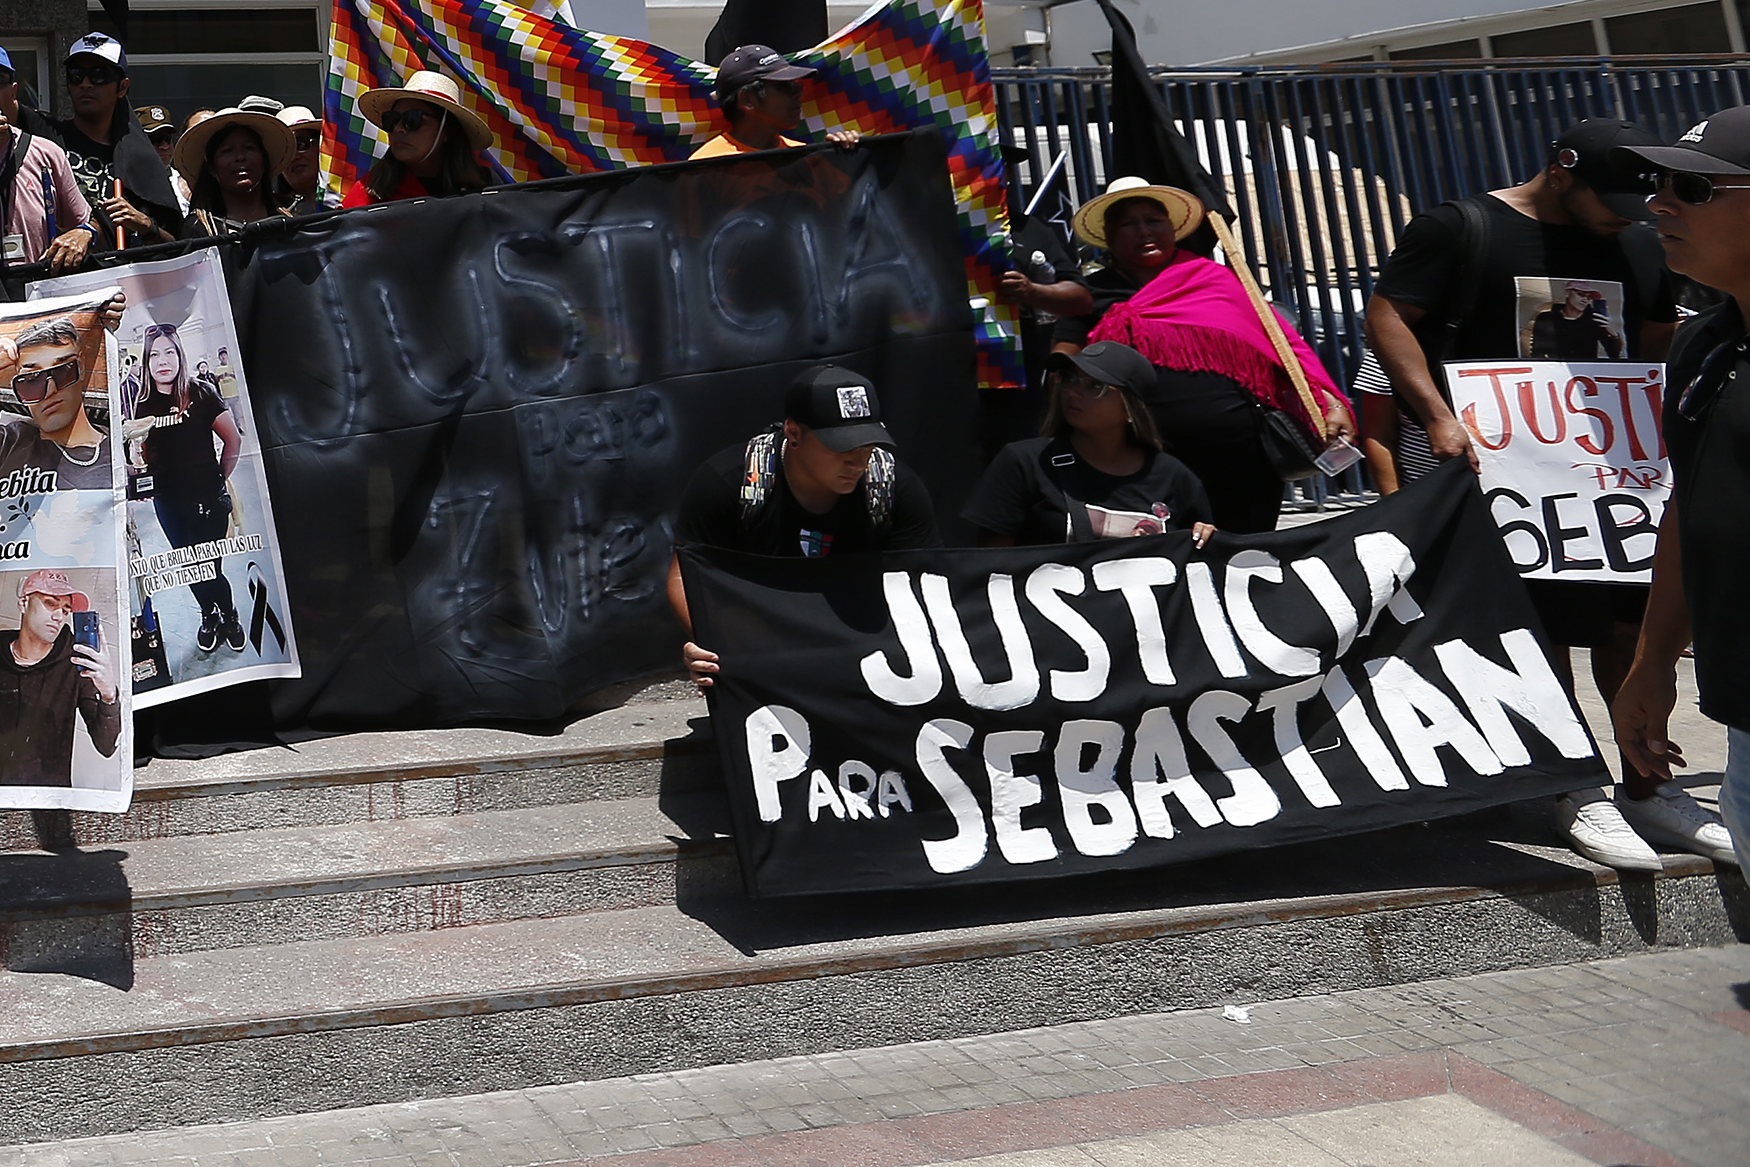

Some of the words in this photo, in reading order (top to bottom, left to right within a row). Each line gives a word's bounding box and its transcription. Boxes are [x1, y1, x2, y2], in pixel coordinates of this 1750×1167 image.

[258, 186, 934, 452] JUSTICIA
[1458, 368, 1667, 462] JUSTI
[1570, 463, 1674, 490] PAR
[149, 554, 166, 574] QUE
[166, 547, 196, 567] BRILLA
[196, 542, 218, 560] PARA
[218, 540, 229, 555] TI
[229, 537, 246, 553] LAS
[247, 534, 262, 551] LUZ
[1484, 488, 1659, 574] SEB
[144, 575, 161, 596] QUE
[162, 572, 174, 588] NO
[175, 566, 200, 584] TIENE
[200, 563, 216, 580] FIN
[860, 531, 1424, 710] JUSTICIA
[746, 704, 912, 823] PARA
[916, 628, 1594, 874] SEBASTIAN
